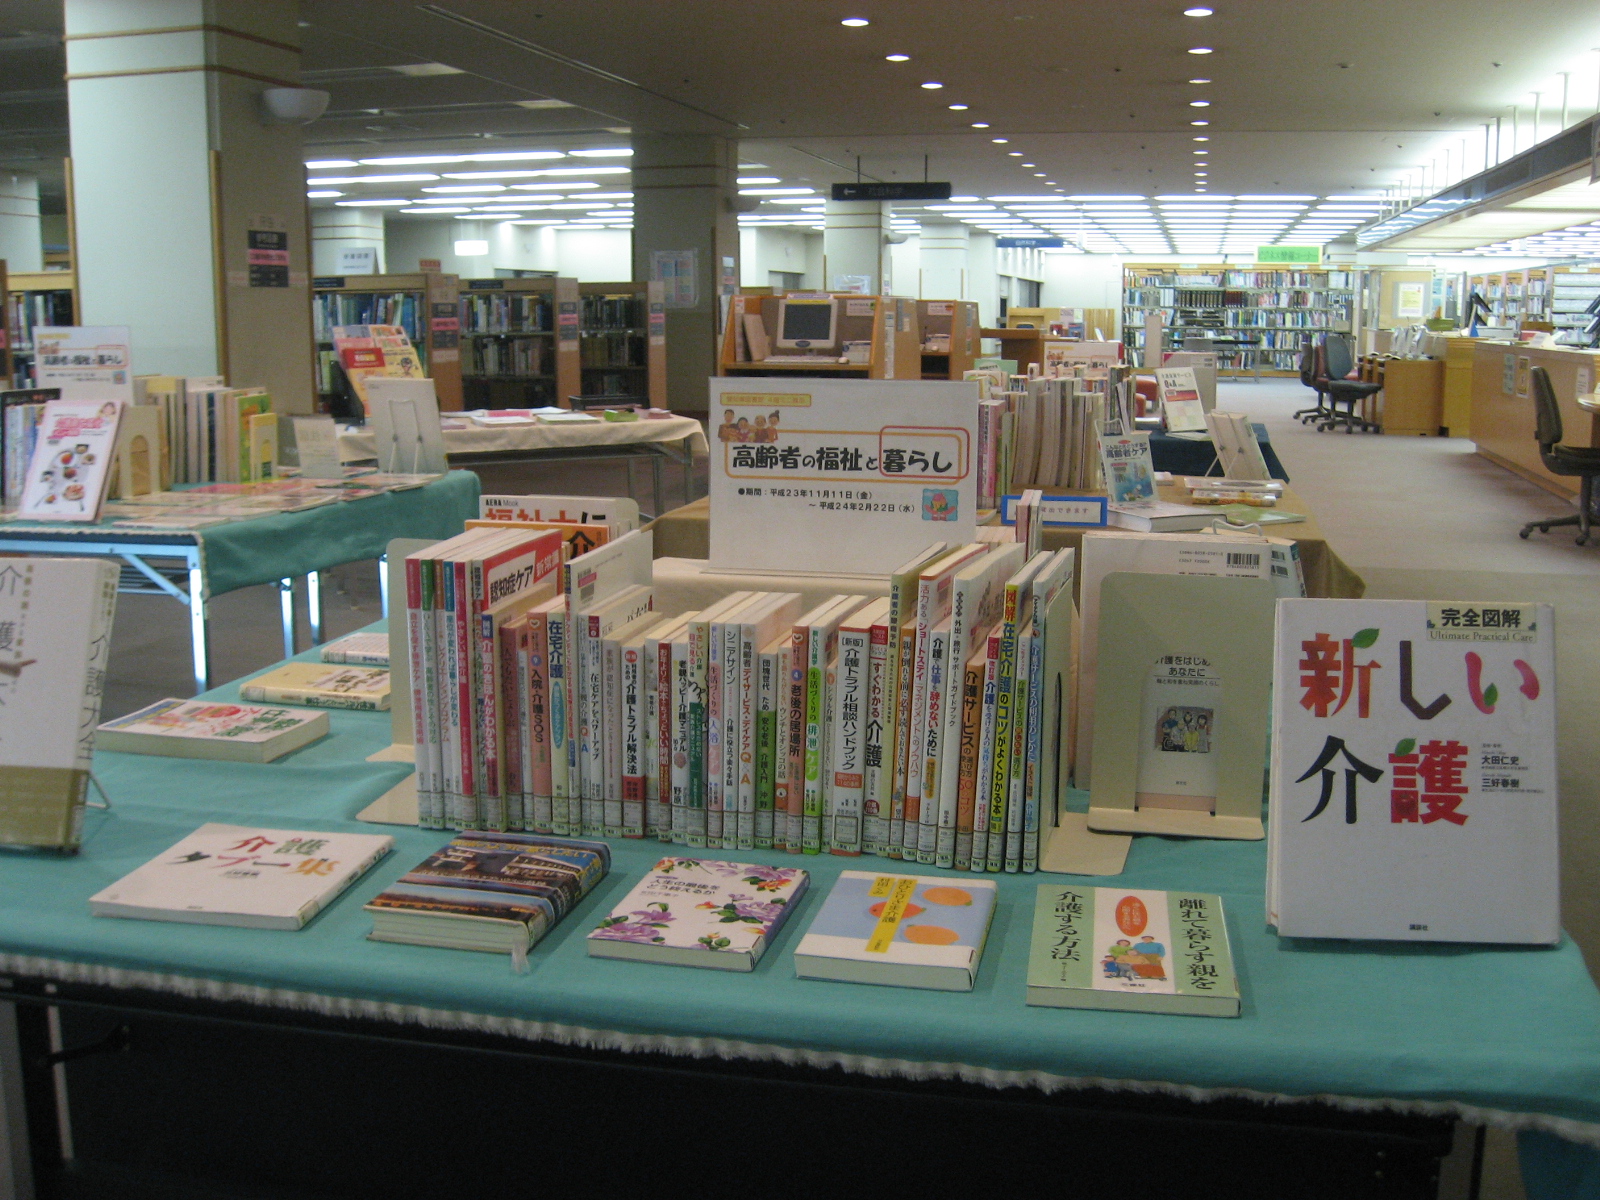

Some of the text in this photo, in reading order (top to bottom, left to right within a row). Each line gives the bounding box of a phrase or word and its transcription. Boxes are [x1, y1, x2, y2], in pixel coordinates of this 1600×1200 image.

[732, 445, 953, 473] 高齢者の福祉と暮らし
[485, 499, 502, 507] AERA
[490, 564, 534, 604] 認知症ケア
[1430, 631, 1534, 642] Ultimate Practical Care
[1441, 608, 1521, 629] 完全図解
[548, 621, 563, 678] 在宅介護
[725, 631, 736, 685] シニアサイン
[1168, 667, 1206, 677] あなたに
[1299, 632, 1540, 720] 新しい
[625, 683, 638, 775] 介護トラブル解決法
[789, 684, 802, 757] 老後の居場所
[842, 648, 860, 771] 介護トラブル相談ハンドブック
[866, 662, 884, 769] すぐわかる 介護
[1295, 735, 1469, 826] 介護
[1481, 755, 1519, 766] 大田仁史
[1481, 777, 1519, 788] 三好春樹
[1050, 891, 1083, 962] 介護する方法
[1179, 898, 1220, 990] 離れて暮らす親を
